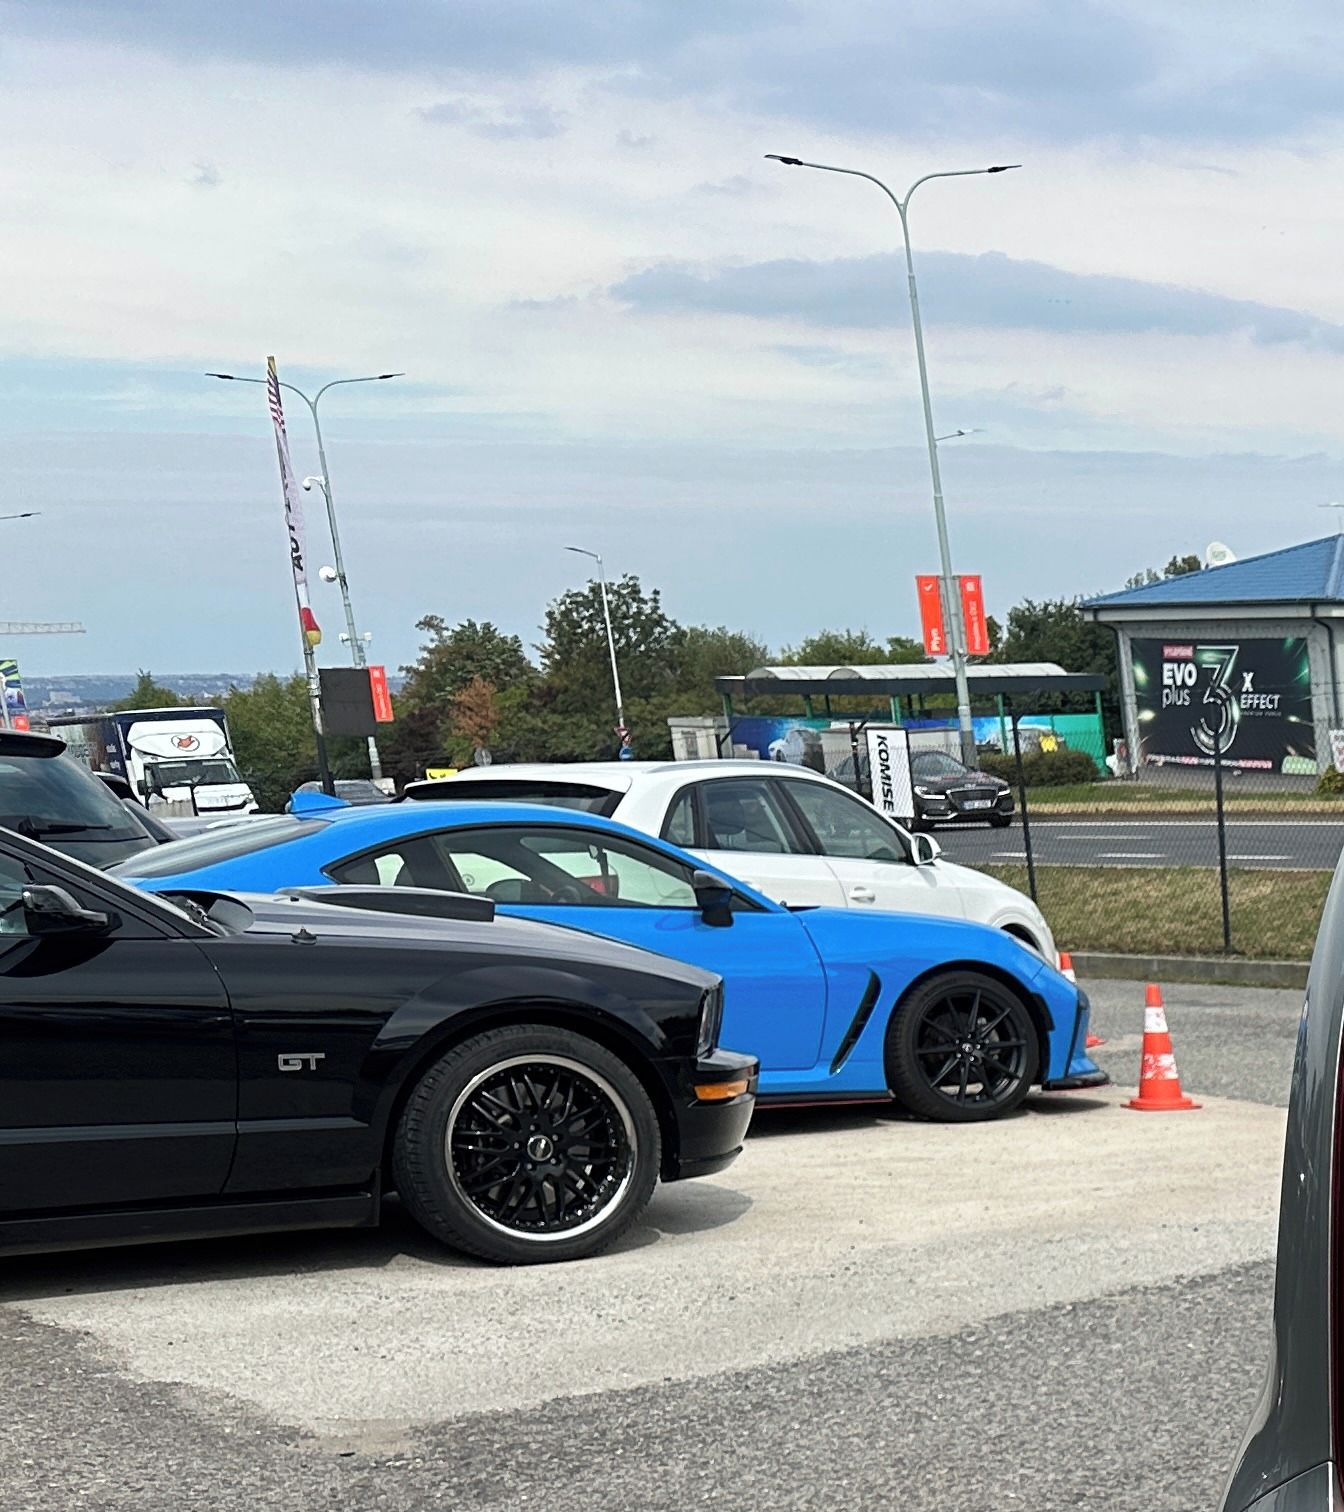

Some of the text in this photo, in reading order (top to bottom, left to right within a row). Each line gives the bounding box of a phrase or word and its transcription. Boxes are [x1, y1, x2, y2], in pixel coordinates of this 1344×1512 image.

[1162, 662, 1198, 687] EVO
[1162, 684, 1191, 709] plus
[1240, 694, 1281, 710] EFFECT
[876, 734, 894, 813] KOMISE
[277, 1052, 326, 1072] GT
